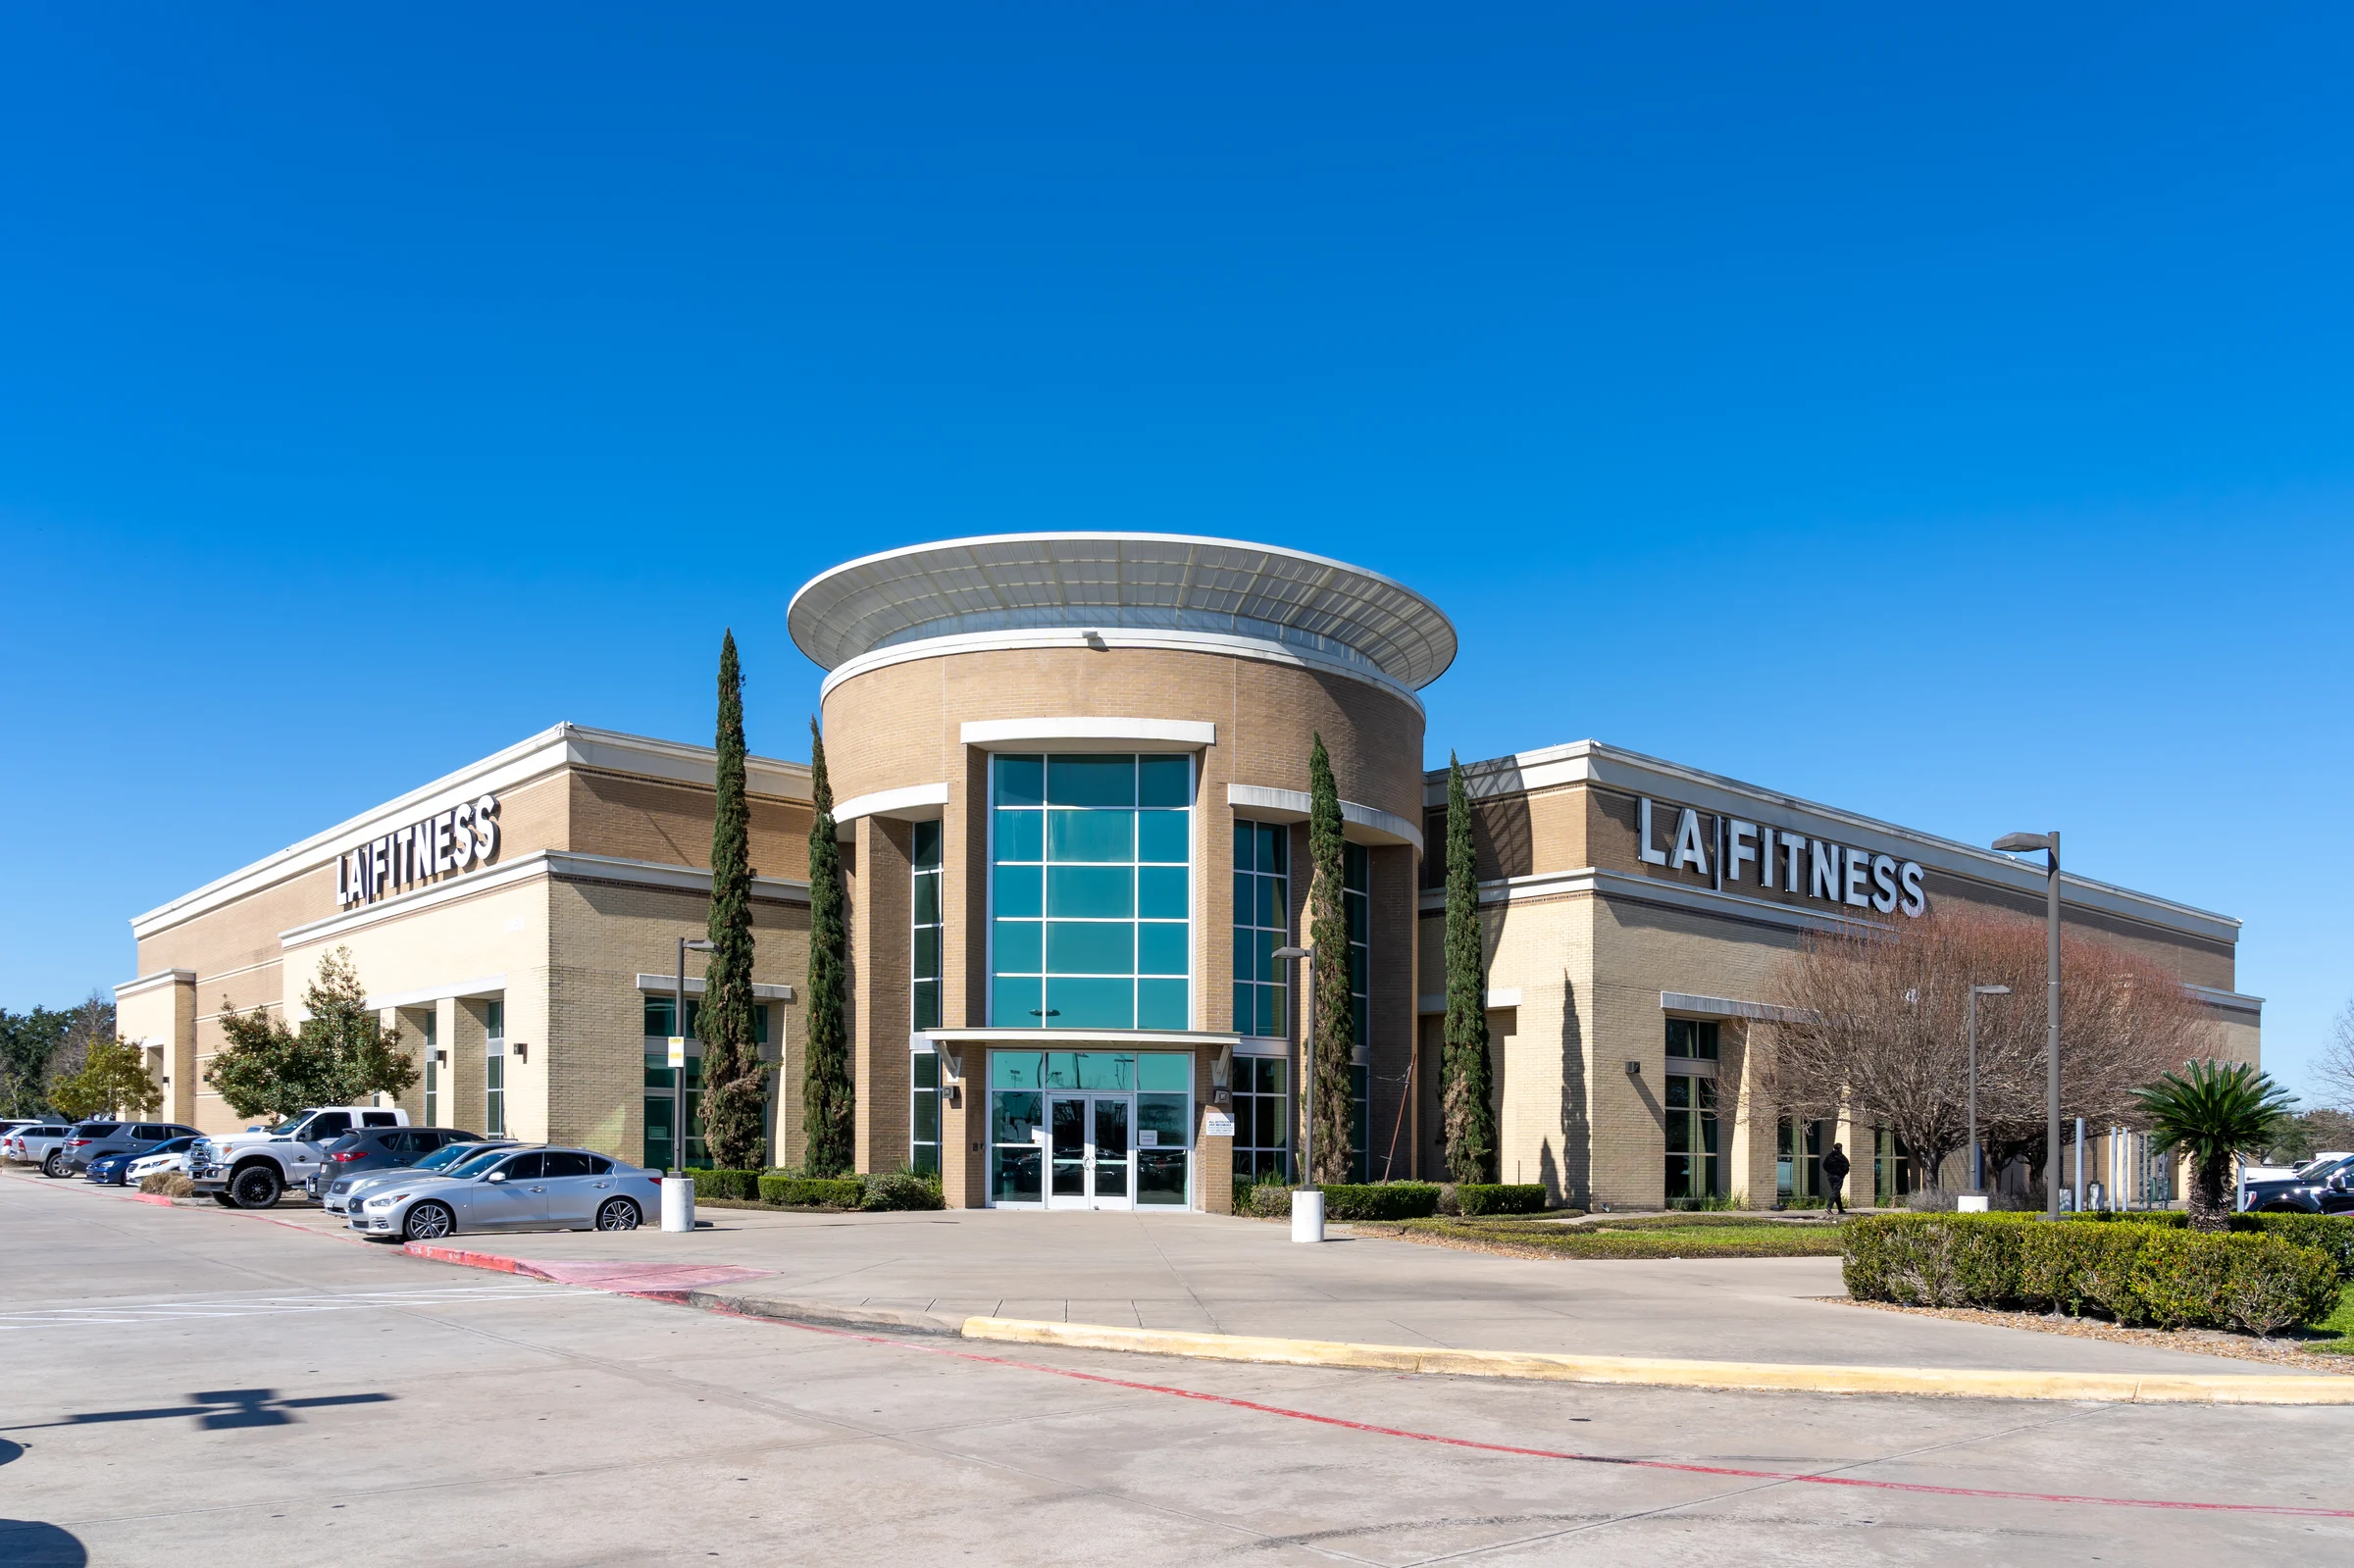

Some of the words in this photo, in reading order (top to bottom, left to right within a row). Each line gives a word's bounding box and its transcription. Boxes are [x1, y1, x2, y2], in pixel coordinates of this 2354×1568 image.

[335, 848, 365, 906] LA
[372, 795, 499, 895] FITNESS
[1639, 796, 1709, 875] LA
[1727, 818, 1924, 918] FITNESS
